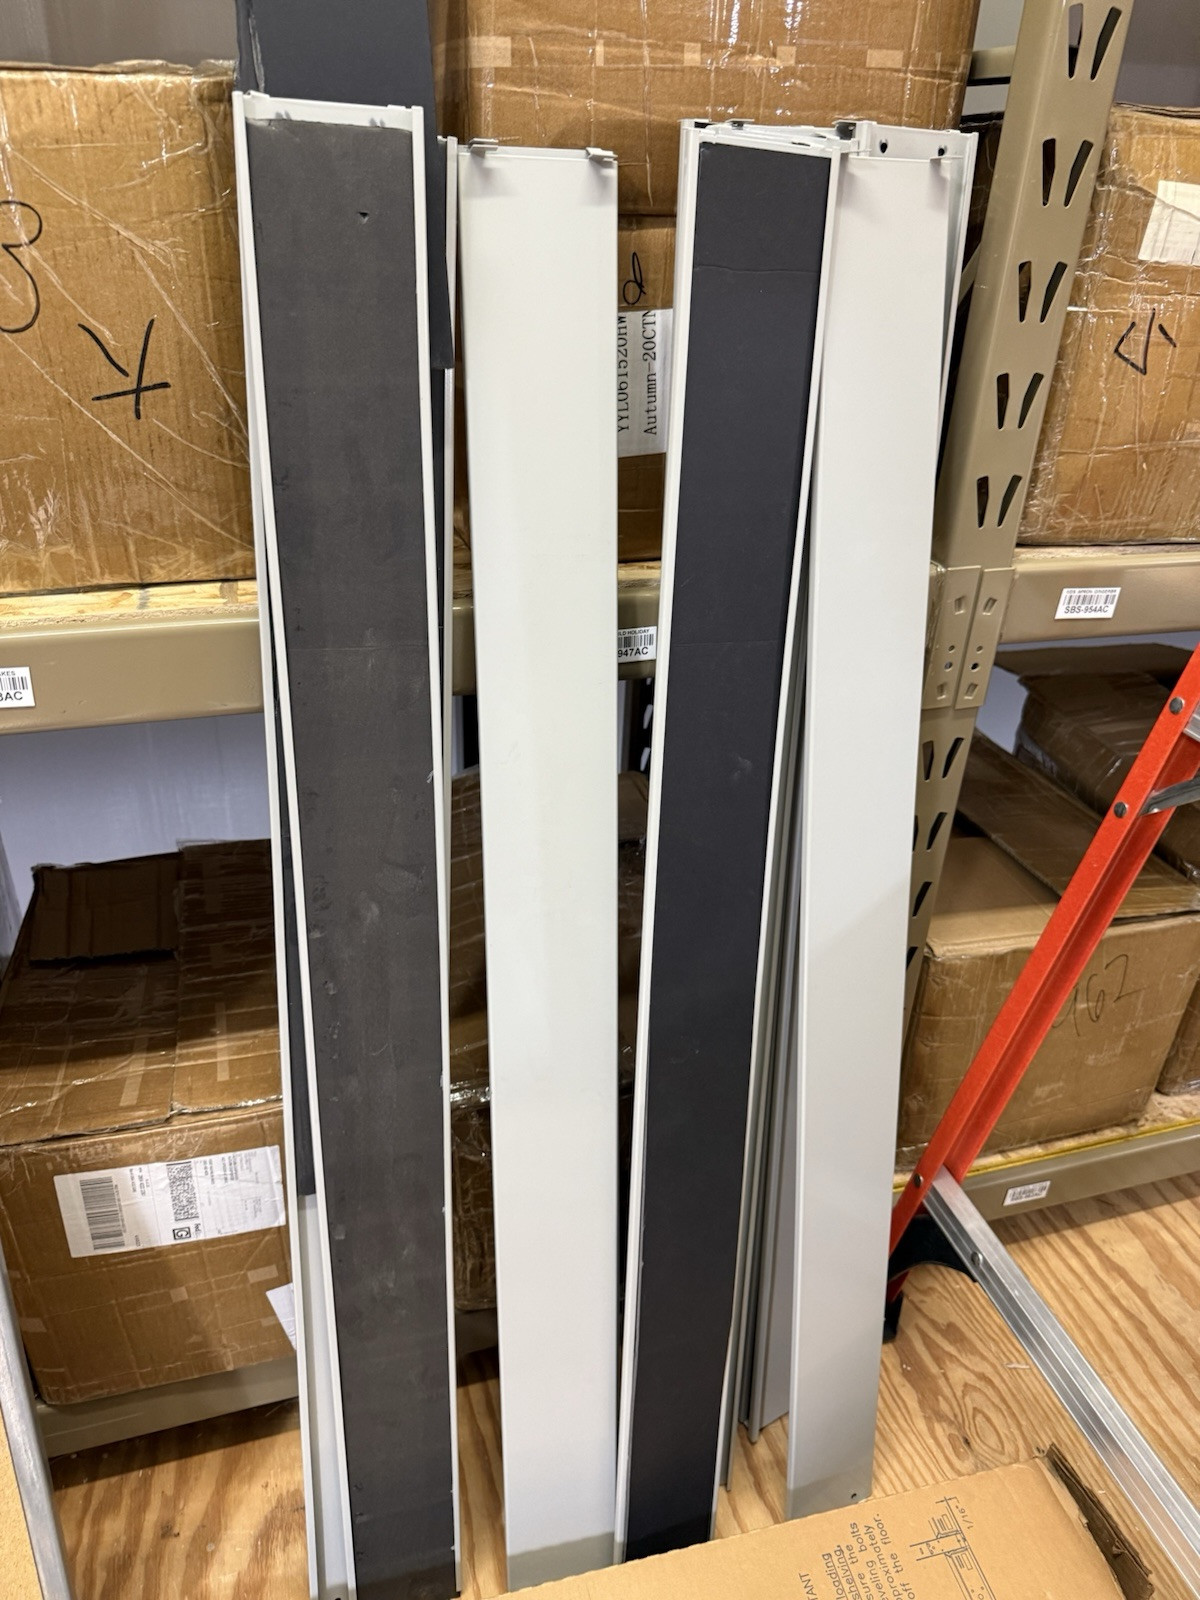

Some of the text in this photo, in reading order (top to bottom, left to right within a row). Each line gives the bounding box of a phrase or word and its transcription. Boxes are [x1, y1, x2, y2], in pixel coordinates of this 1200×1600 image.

[1064, 605, 1109, 614] SBS-954AC
[850, 1522, 867, 1553] bolts
[873, 1513, 916, 1600] off the floor.
[822, 1553, 846, 1600] loading
[846, 1544, 874, 1600] sure the
